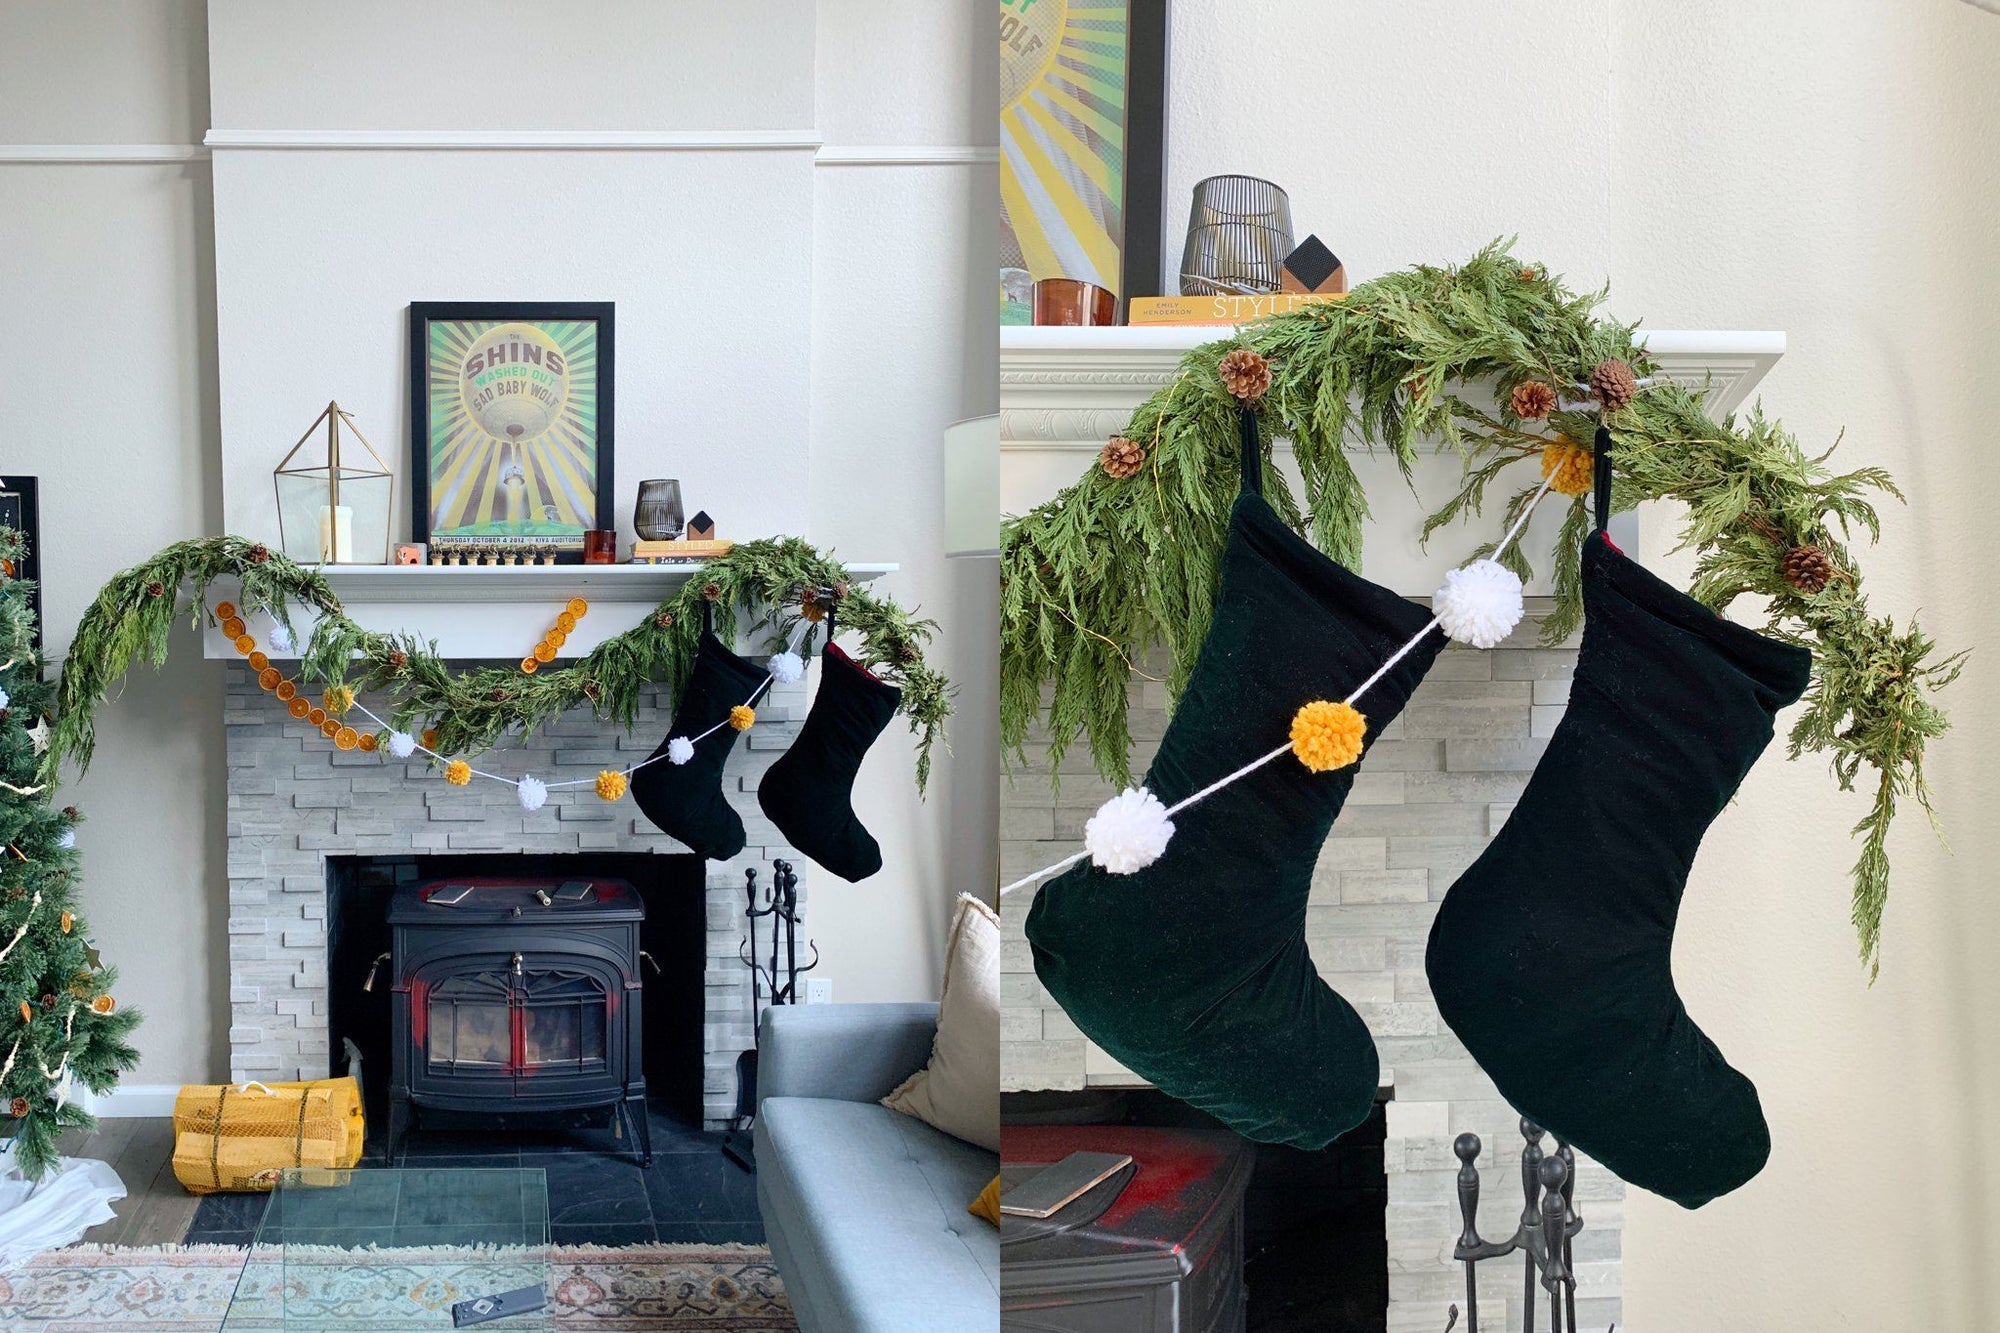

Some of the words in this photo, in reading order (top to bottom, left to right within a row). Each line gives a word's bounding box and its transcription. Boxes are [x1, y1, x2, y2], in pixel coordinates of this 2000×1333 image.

[1000, 11, 1042, 56] OLF
[466, 342, 564, 379] SHINS
[475, 366, 528, 386] WASHED
[531, 369, 557, 386] OUT
[473, 387, 494, 412] SAD
[497, 380, 527, 397] BABY
[530, 383, 560, 408] WOLF
